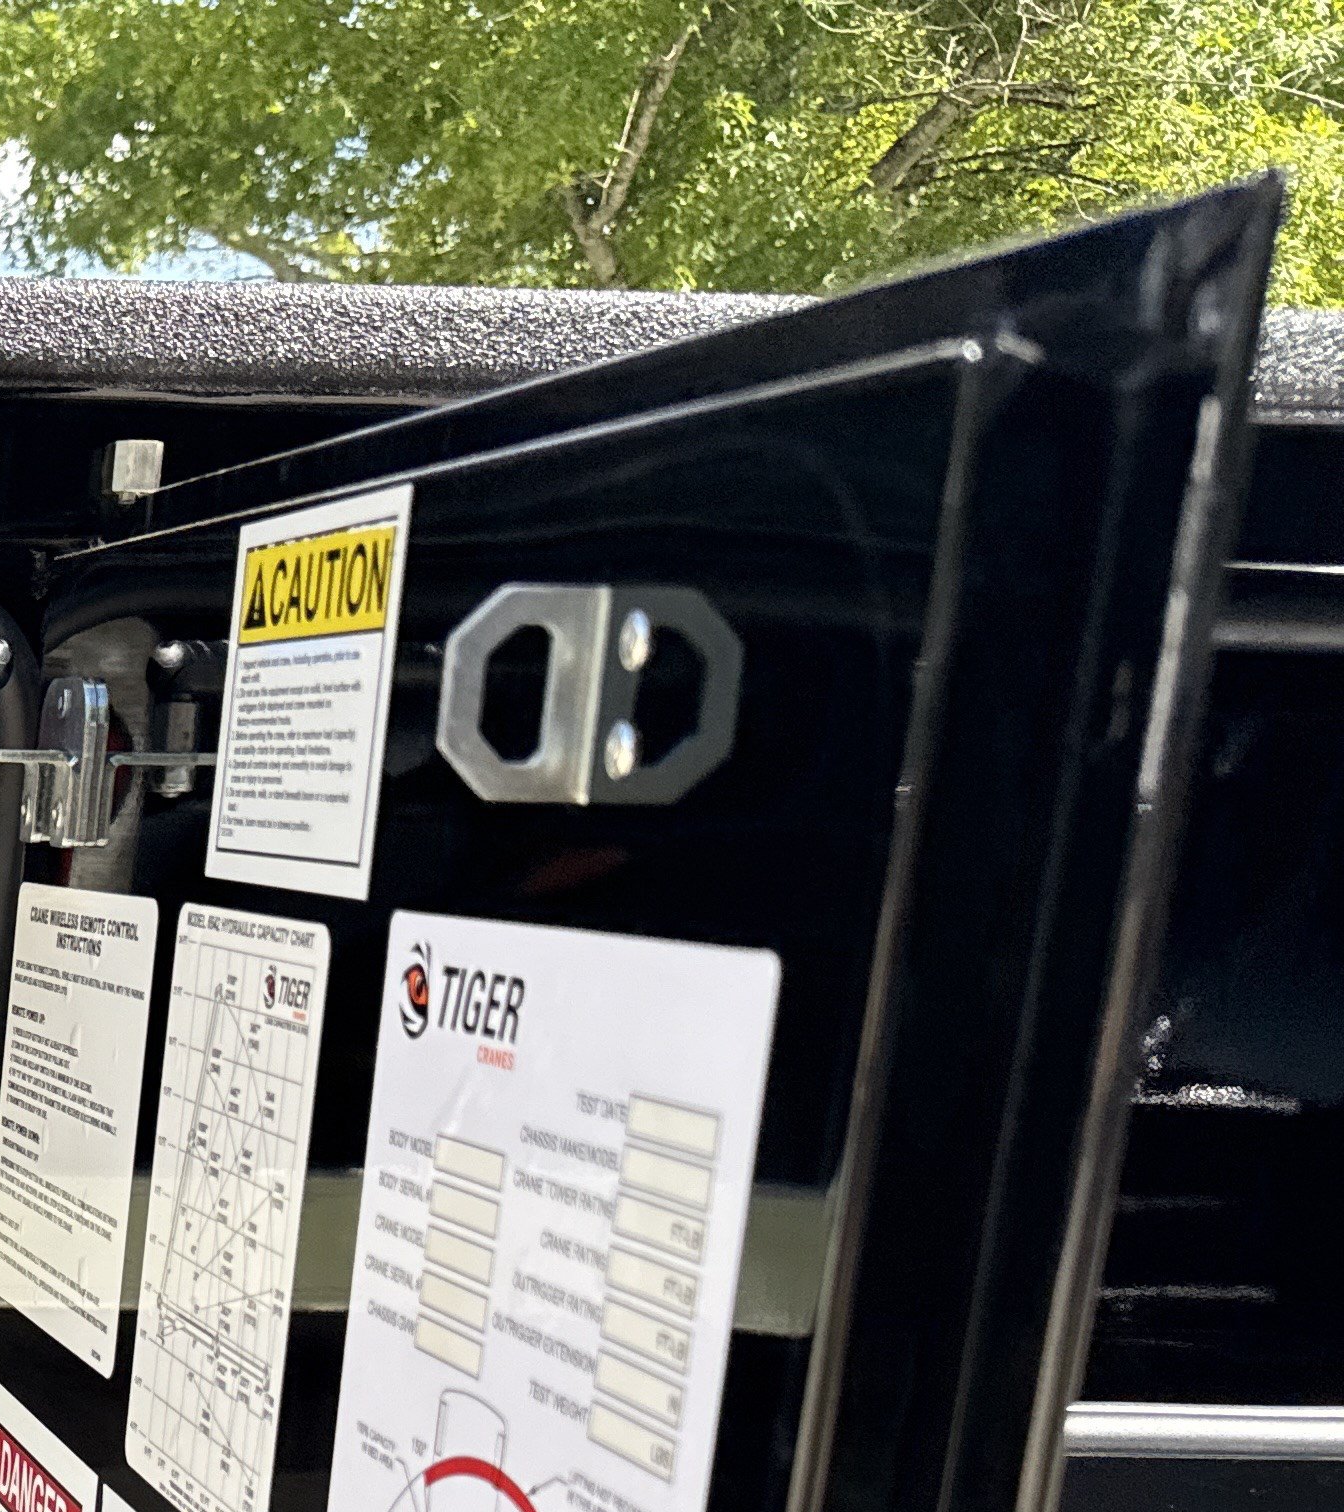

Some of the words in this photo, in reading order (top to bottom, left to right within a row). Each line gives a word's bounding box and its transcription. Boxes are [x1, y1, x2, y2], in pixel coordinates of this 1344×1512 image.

[267, 537, 390, 627] CAUTION
[30, 906, 48, 924] CRANE
[50, 909, 78, 929] WIRELESS
[80, 914, 105, 935] REMOTE
[107, 919, 139, 941] CONTROL
[56, 932, 101, 956] INSTRUCTIONS
[278, 975, 310, 1009] TIGER
[436, 964, 525, 1044] TIGER
[476, 1043, 515, 1072] CRANES
